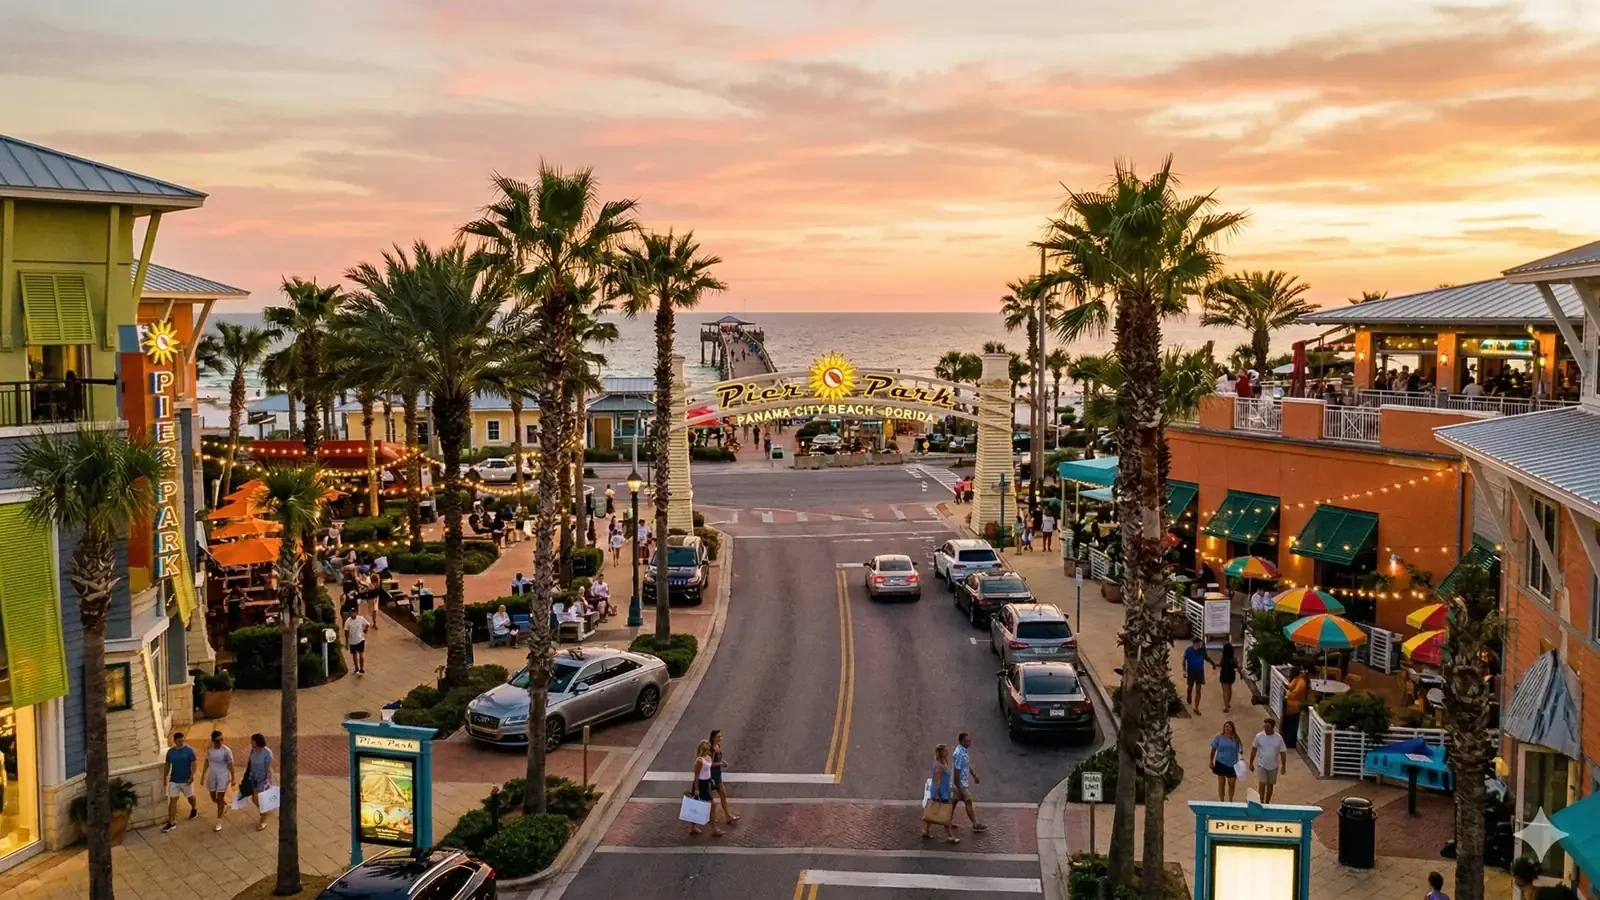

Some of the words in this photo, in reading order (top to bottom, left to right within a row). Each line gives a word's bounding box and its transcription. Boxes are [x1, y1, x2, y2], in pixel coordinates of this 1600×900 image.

[715, 382, 803, 410] Pier
[864, 374, 956, 407] Park
[153, 371, 176, 468] PIER
[737, 407, 792, 426] PANAMA
[795, 404, 825, 417] CITY
[828, 404, 874, 415] BEACH
[158, 481, 179, 578] PARK
[359, 736, 383, 746] Pier
[387, 739, 413, 749] Park
[1215, 821, 1248, 831] Pier
[1254, 823, 1293, 834] Park
